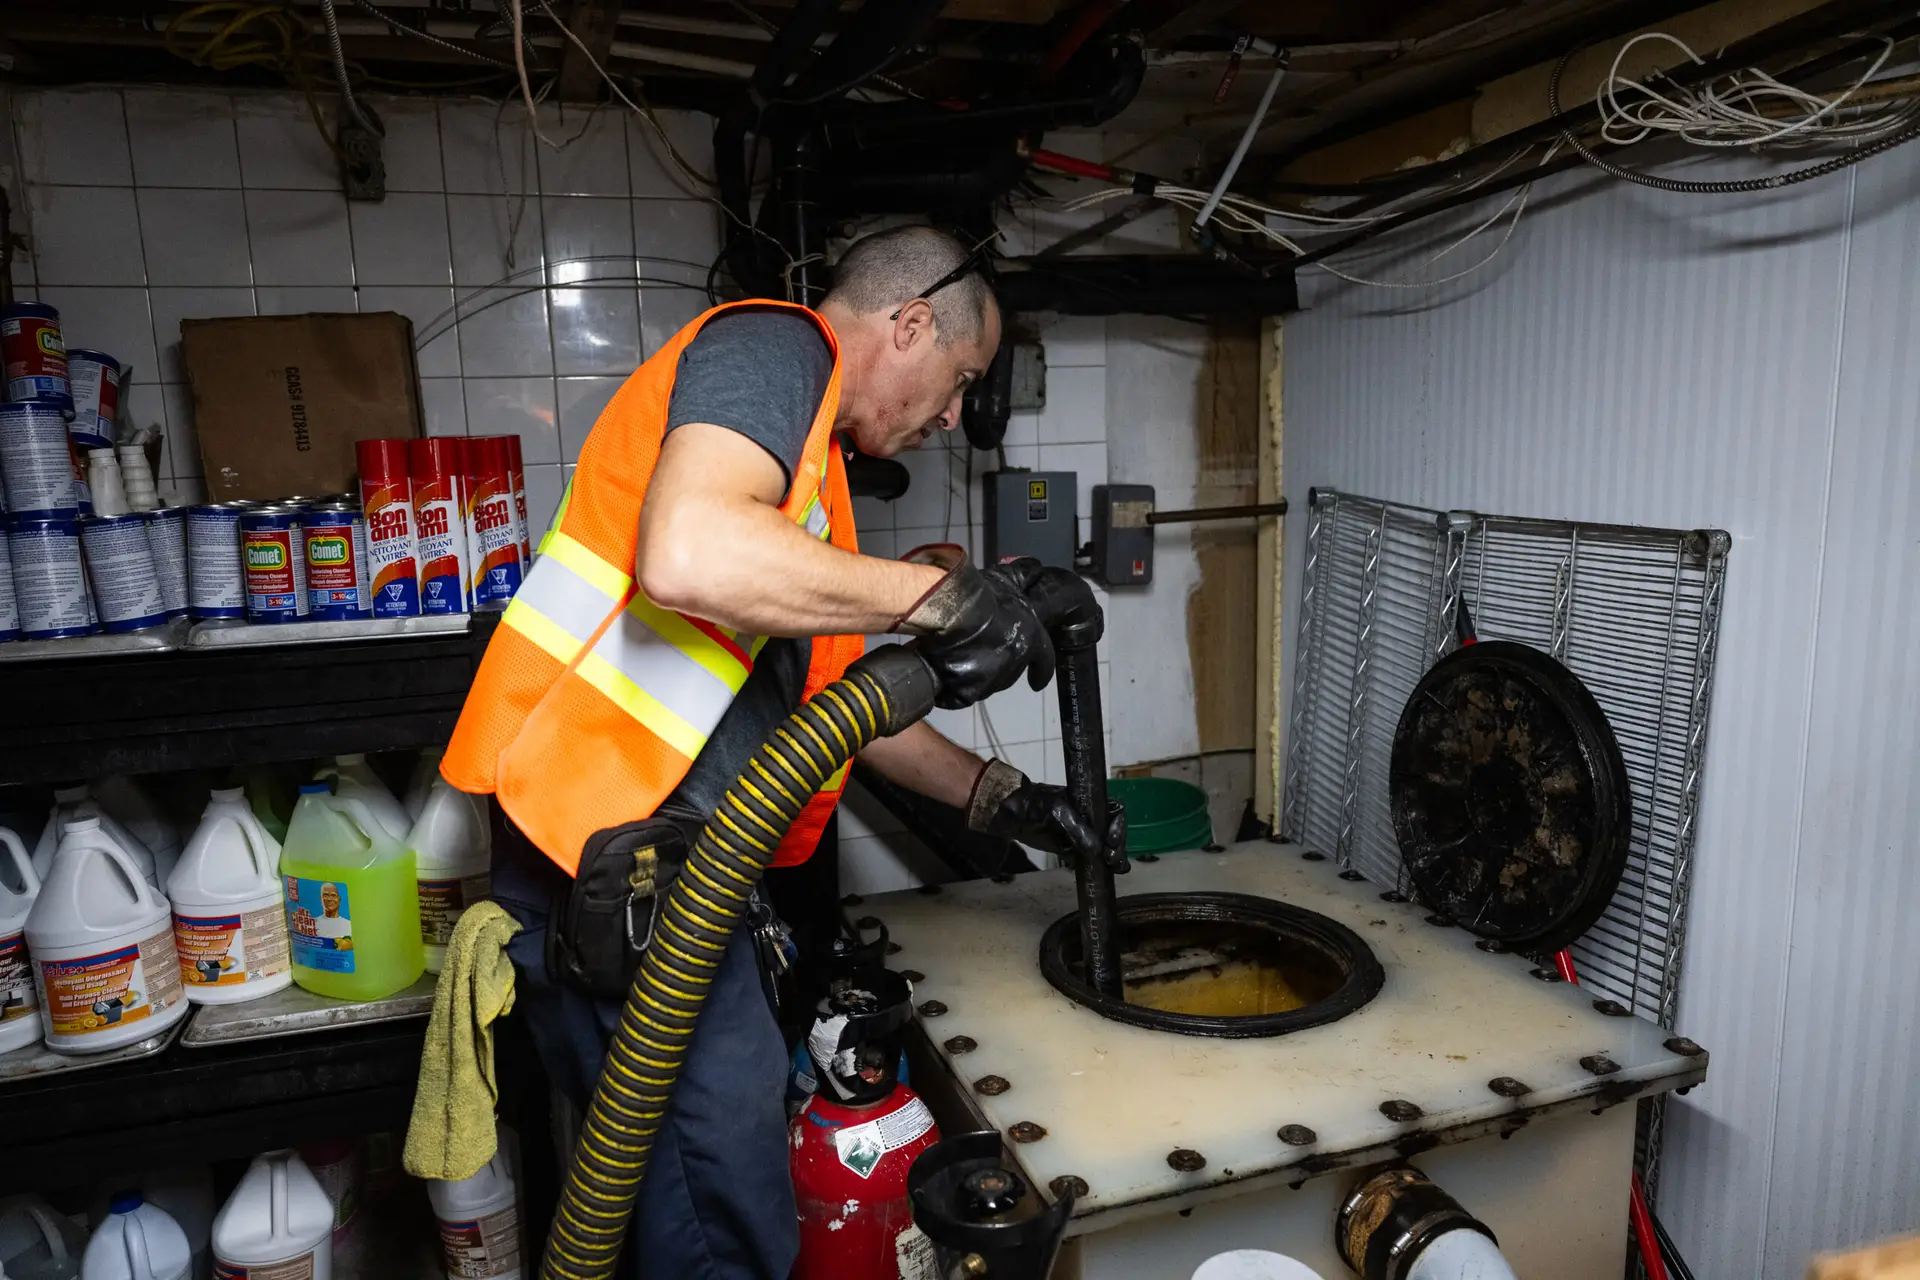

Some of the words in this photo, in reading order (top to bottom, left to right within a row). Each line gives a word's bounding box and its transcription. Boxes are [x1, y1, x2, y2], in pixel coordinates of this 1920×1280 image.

[369, 508, 407, 529] Bon
[416, 507, 448, 526] Bon
[371, 522, 408, 542] ami
[417, 520, 448, 540] ami
[248, 548, 281, 564] Comet
[311, 543, 344, 560] Comet
[369, 540, 412, 557] NETTOYANT
[382, 550, 408, 562] VITRES
[268, 598, 282, 606] 3-10
[332, 592, 345, 600] 3-10
[290, 912, 316, 927] Clean
[298, 907, 310, 918] Mr.
[301, 925, 318, 937] Net
[1088, 906, 1103, 981] CHARLOTTE
[73, 999, 96, 1007] Grease
[97, 991, 127, 1003] Remover
[74, 991, 101, 1001] Purpose
[102, 984, 129, 995] Cleaner
